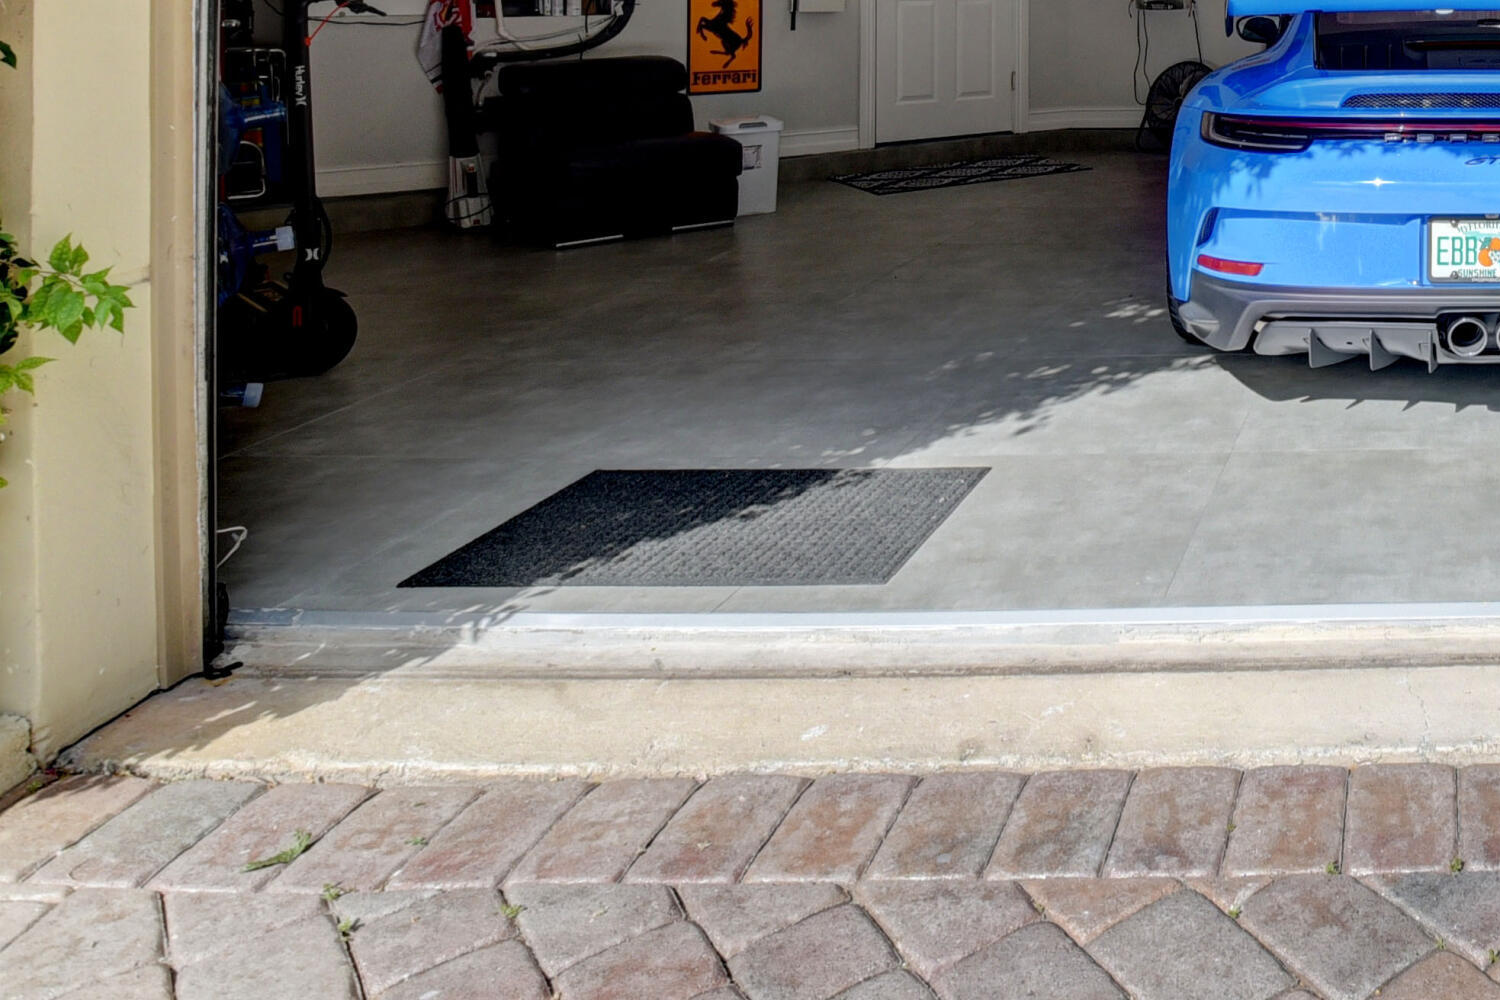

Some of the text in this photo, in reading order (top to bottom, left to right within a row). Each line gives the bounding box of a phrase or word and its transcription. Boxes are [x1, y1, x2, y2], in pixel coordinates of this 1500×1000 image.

[294, 64, 306, 96] Hurley
[692, 69, 757, 86] Ferrari
[1437, 236, 1478, 266] EBB
[1458, 268, 1497, 278] SUNSHINE
